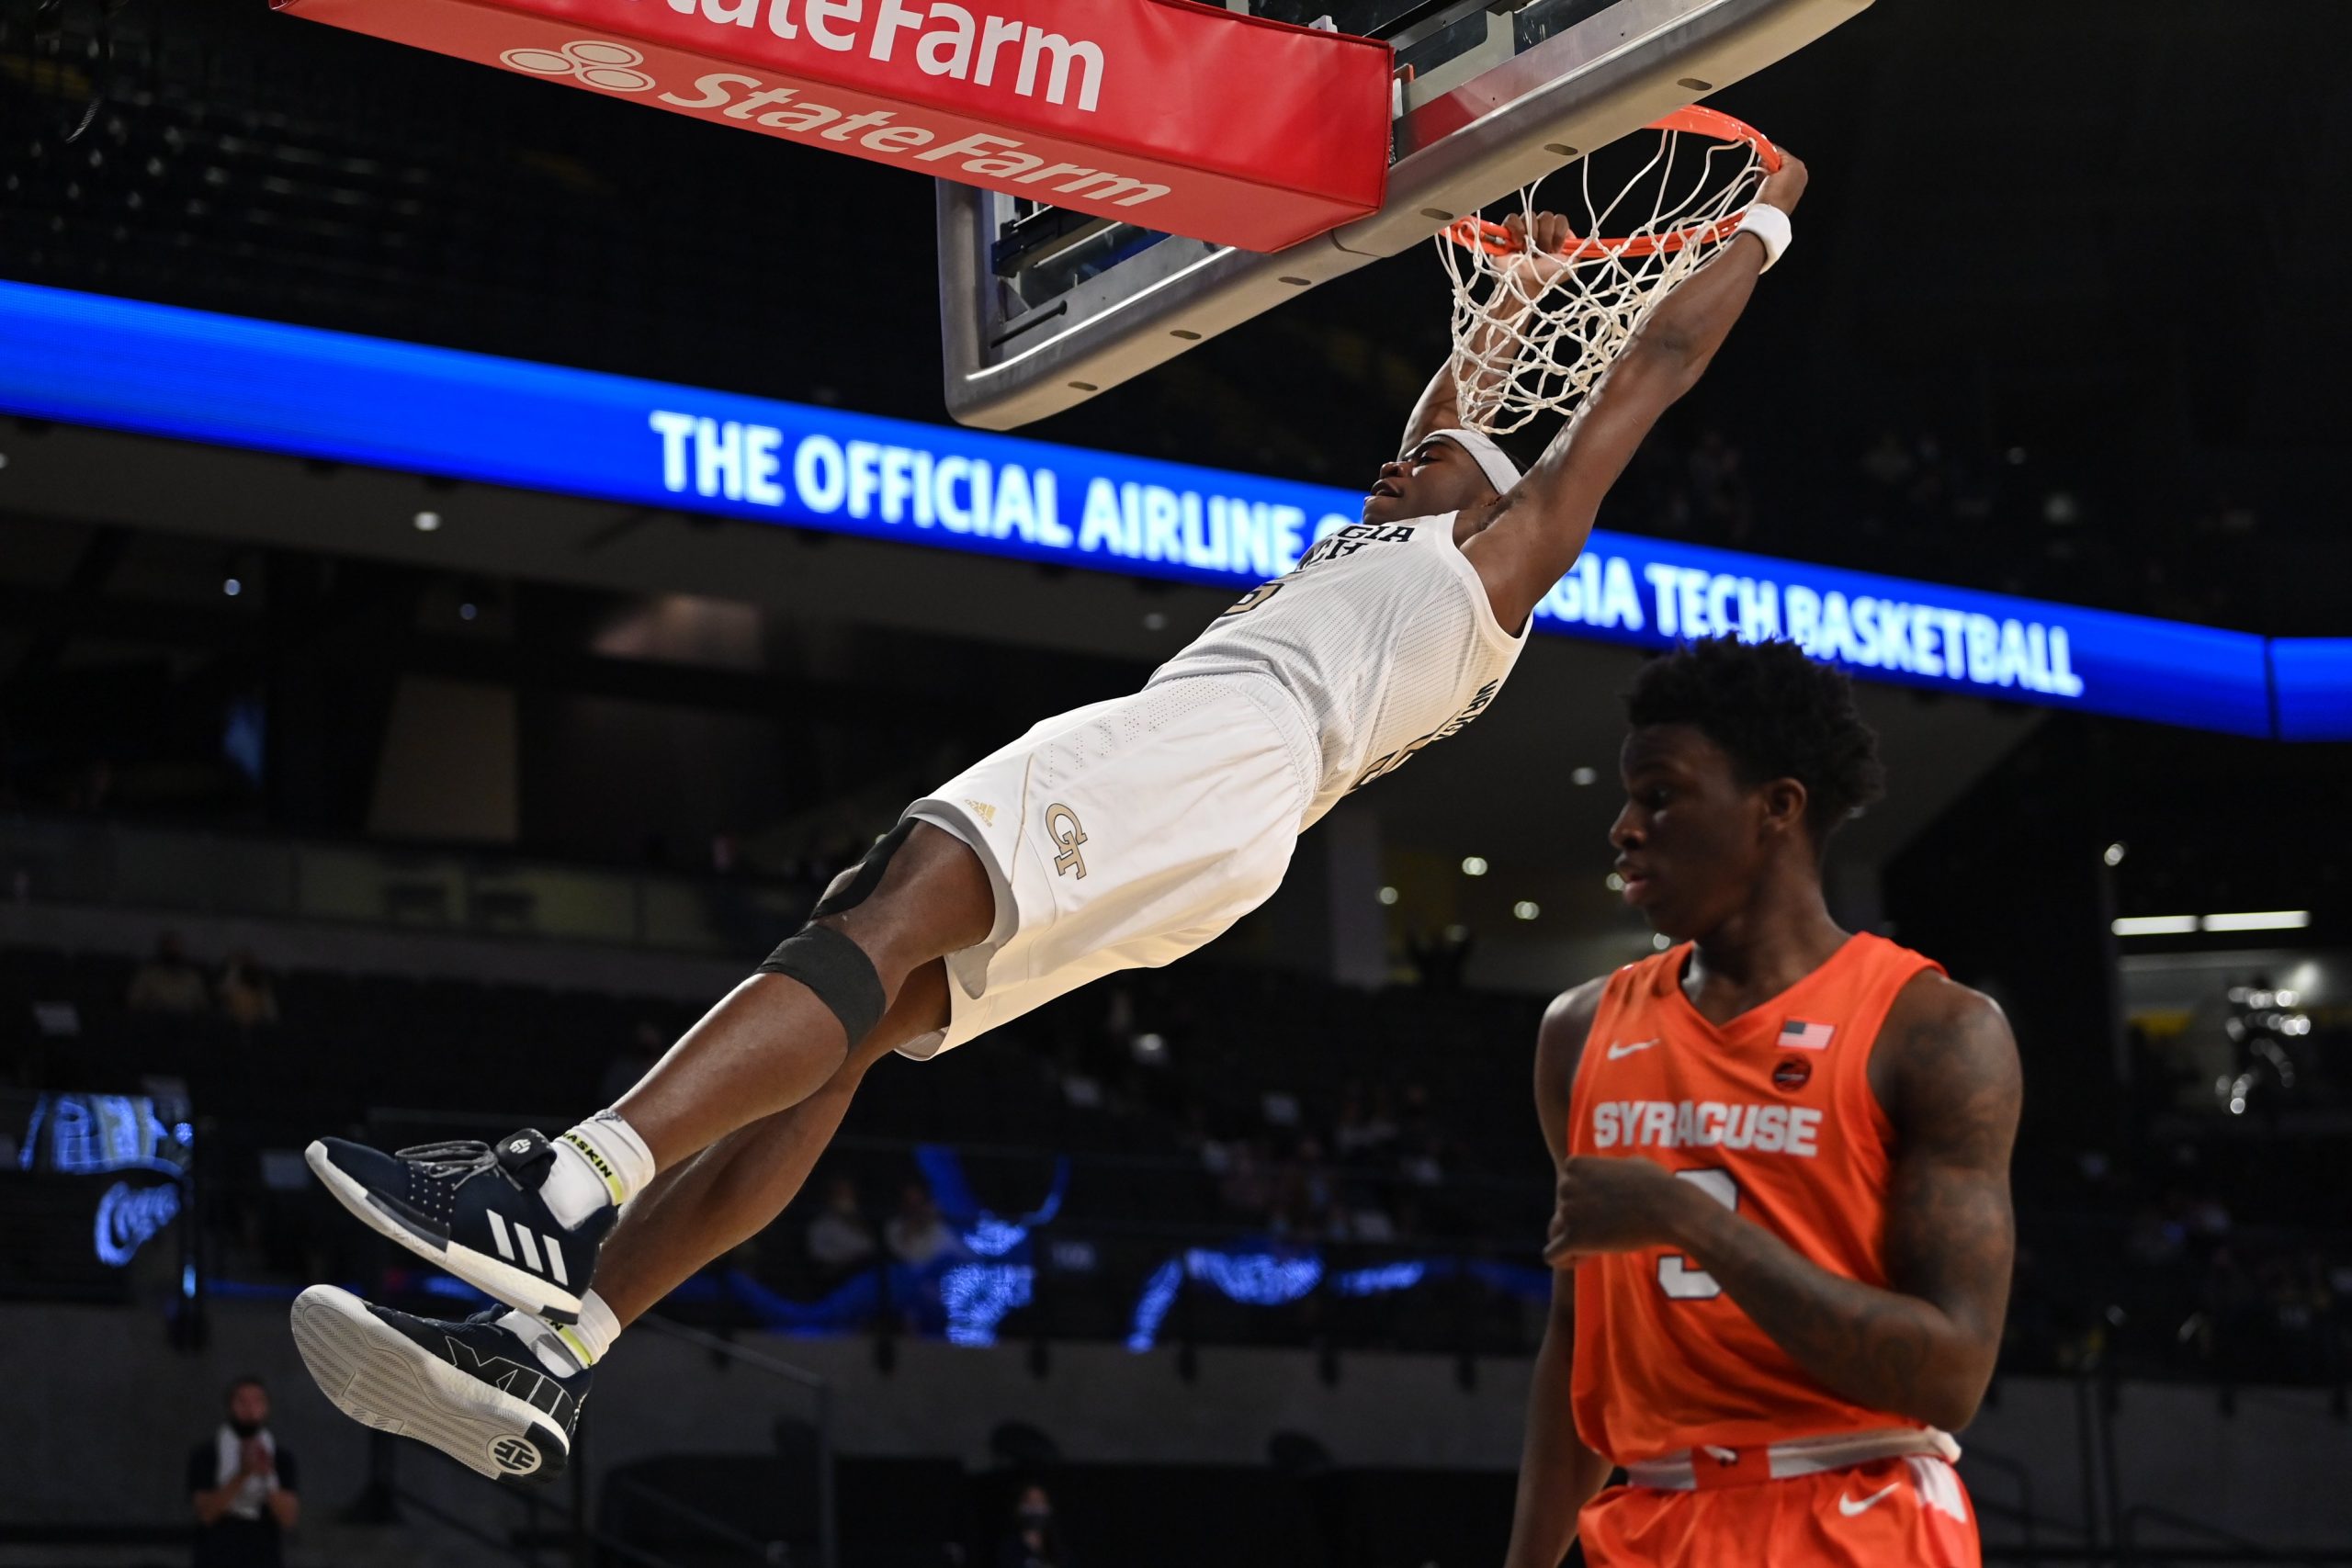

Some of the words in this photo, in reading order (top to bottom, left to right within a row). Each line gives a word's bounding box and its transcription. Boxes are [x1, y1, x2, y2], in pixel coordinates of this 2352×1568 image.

[650, 410, 784, 506] THE
[794, 433, 1073, 549] OFFICIAL
[1079, 476, 1306, 577] AIRLINE
[1533, 551, 1645, 631] GIA
[1644, 562, 1779, 644] TECH
[1784, 583, 2084, 698] BASKETBALL
[1592, 1100, 1824, 1158] SYRACUSE
